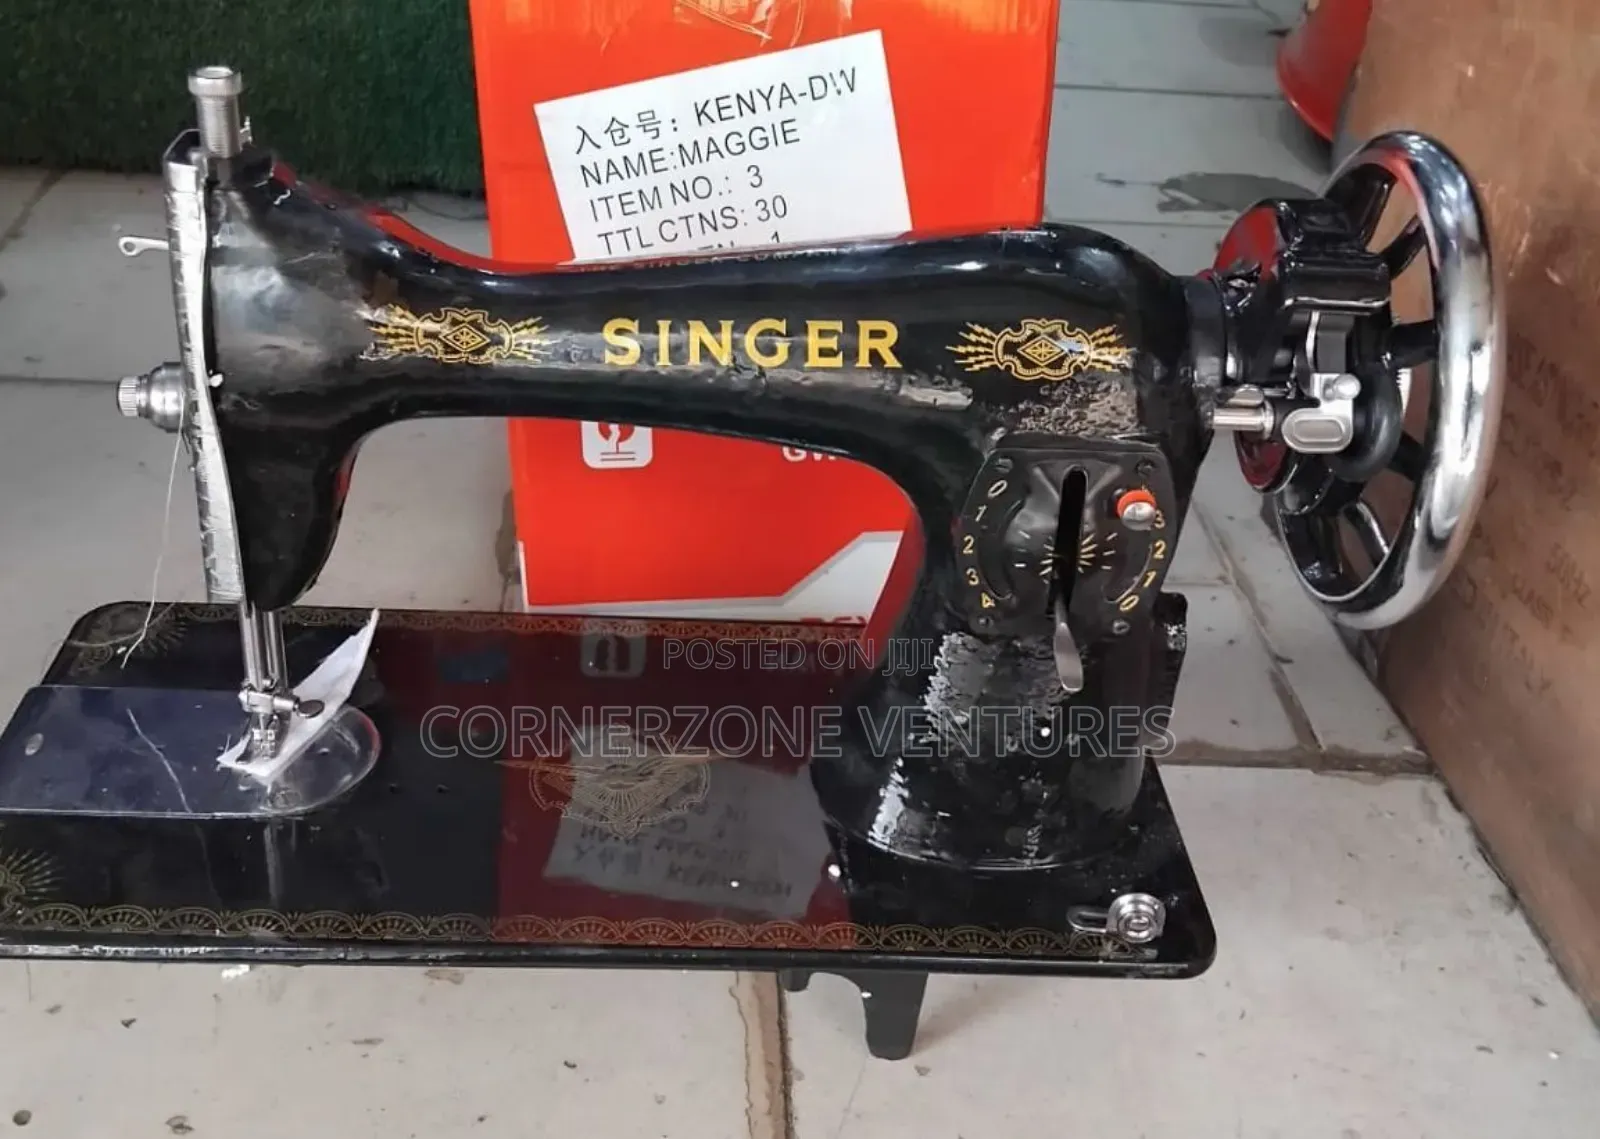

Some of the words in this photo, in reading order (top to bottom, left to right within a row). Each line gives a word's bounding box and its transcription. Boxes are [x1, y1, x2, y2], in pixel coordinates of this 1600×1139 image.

[589, 186, 663, 223] ITEM
[747, 165, 763, 188] 3
[597, 226, 654, 255] TTL
[658, 206, 749, 243] CTNS:
[755, 195, 788, 222] 30
[602, 317, 902, 369] SINGER
[988, 479, 1007, 498] 0
[975, 505, 987, 521] 1
[963, 535, 975, 554] 2
[1154, 541, 1166, 559] 2
[966, 568, 979, 586] 3
[1143, 571, 1156, 588] 1
[981, 593, 995, 608] 4
[1120, 594, 1139, 611] 0
